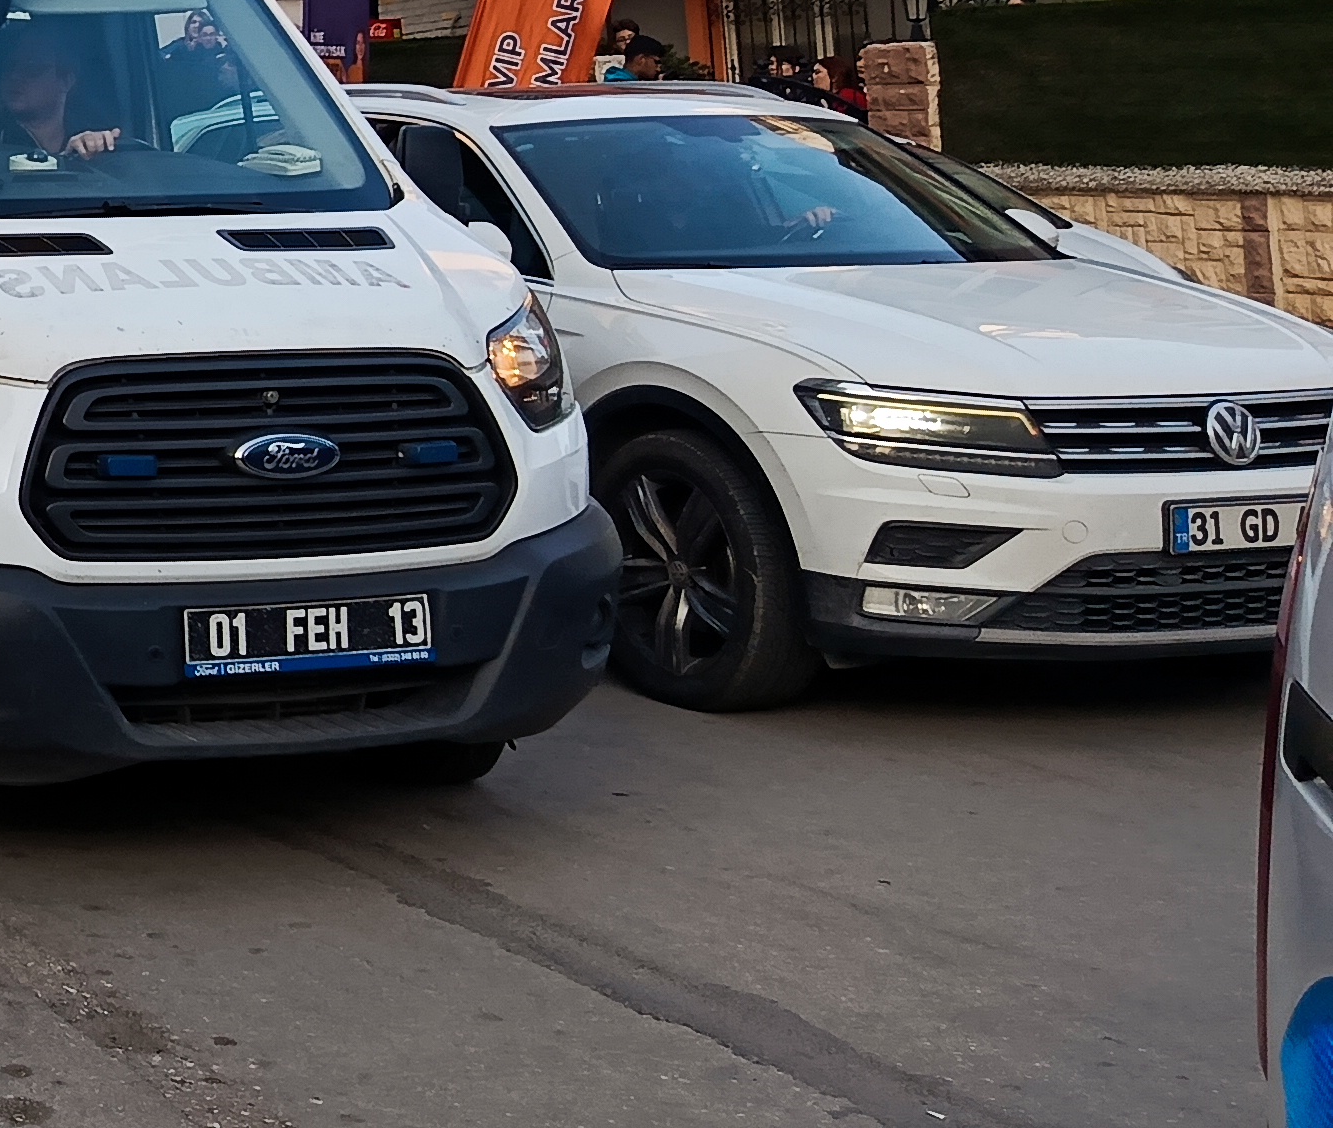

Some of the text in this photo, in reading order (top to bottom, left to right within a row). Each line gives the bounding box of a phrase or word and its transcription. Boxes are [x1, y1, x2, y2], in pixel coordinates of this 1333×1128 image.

[485, 32, 526, 88] VIP
[264, 442, 320, 469] Ford
[1176, 533, 1188, 543] TR
[1190, 507, 1279, 546] 31 GD
[209, 600, 425, 657] 01 FEH 13
